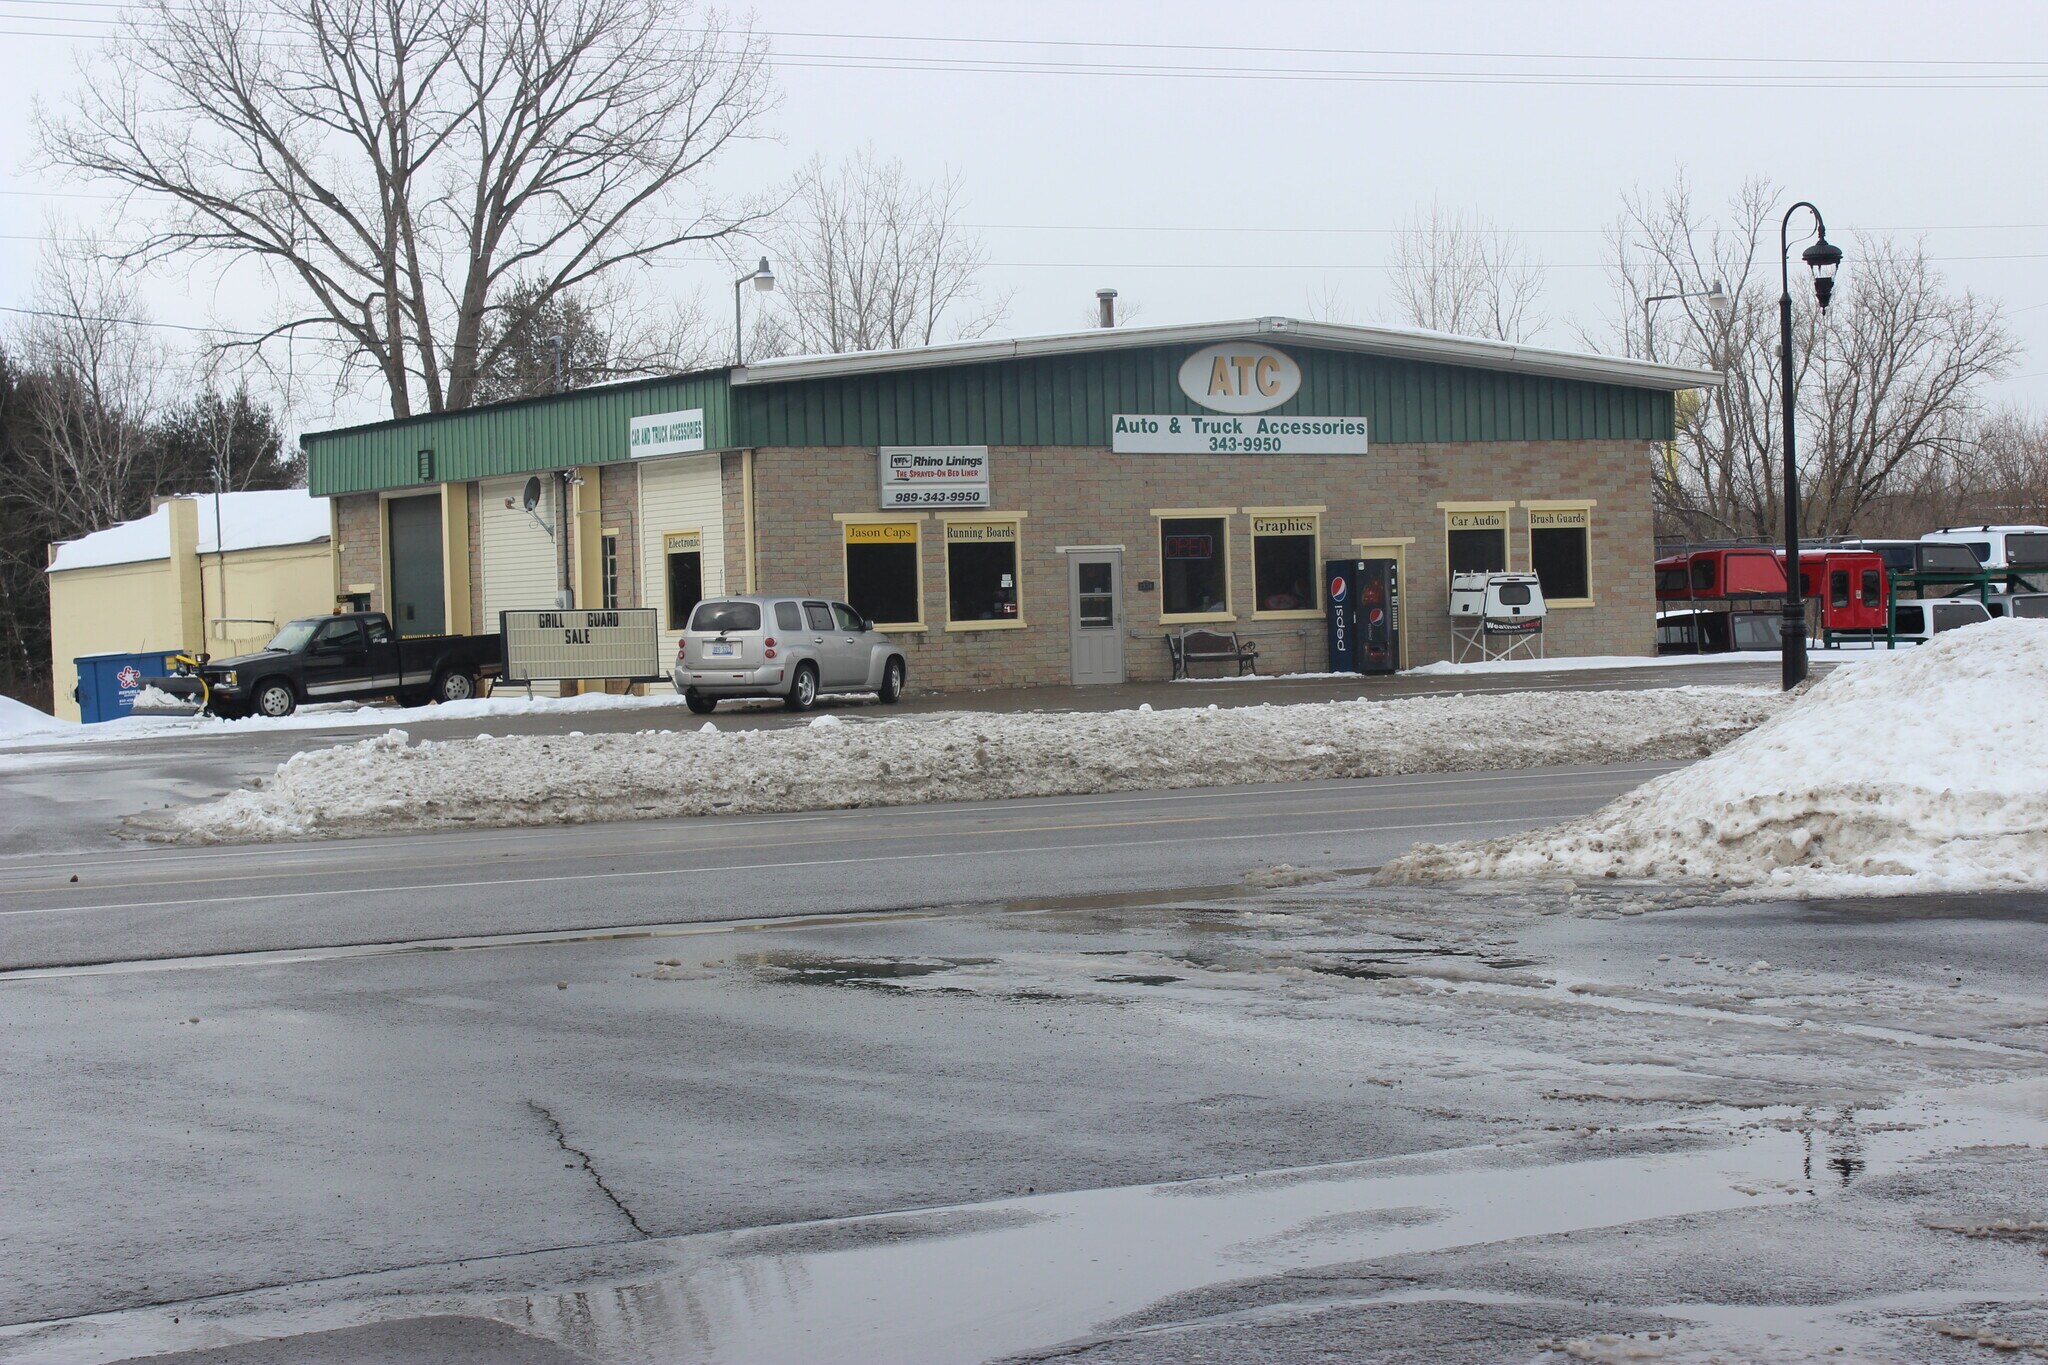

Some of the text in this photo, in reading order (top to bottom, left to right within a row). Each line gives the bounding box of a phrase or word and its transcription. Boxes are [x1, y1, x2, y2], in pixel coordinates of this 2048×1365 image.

[1207, 355, 1281, 397] ATC
[632, 420, 702, 446] CAR AND TRUCK ACCESSORIES
[1115, 417, 1365, 435] Auto & Truck Accessories
[1209, 437, 1282, 452] 343-9950
[913, 456, 983, 468] Rhino Linings
[895, 492, 980, 502] 989-343-9950
[1254, 518, 1313, 534] Graphics
[1451, 515, 1500, 526] Car Audio
[1530, 513, 1585, 524] Brush Guards
[849, 527, 911, 539] Jason Caps
[947, 526, 1015, 539] Running Boards
[1167, 537, 1211, 557] OPEN
[539, 612, 619, 628] GRILL GUARD
[1335, 605, 1346, 651] pepsi
[565, 629, 590, 644] SALE
